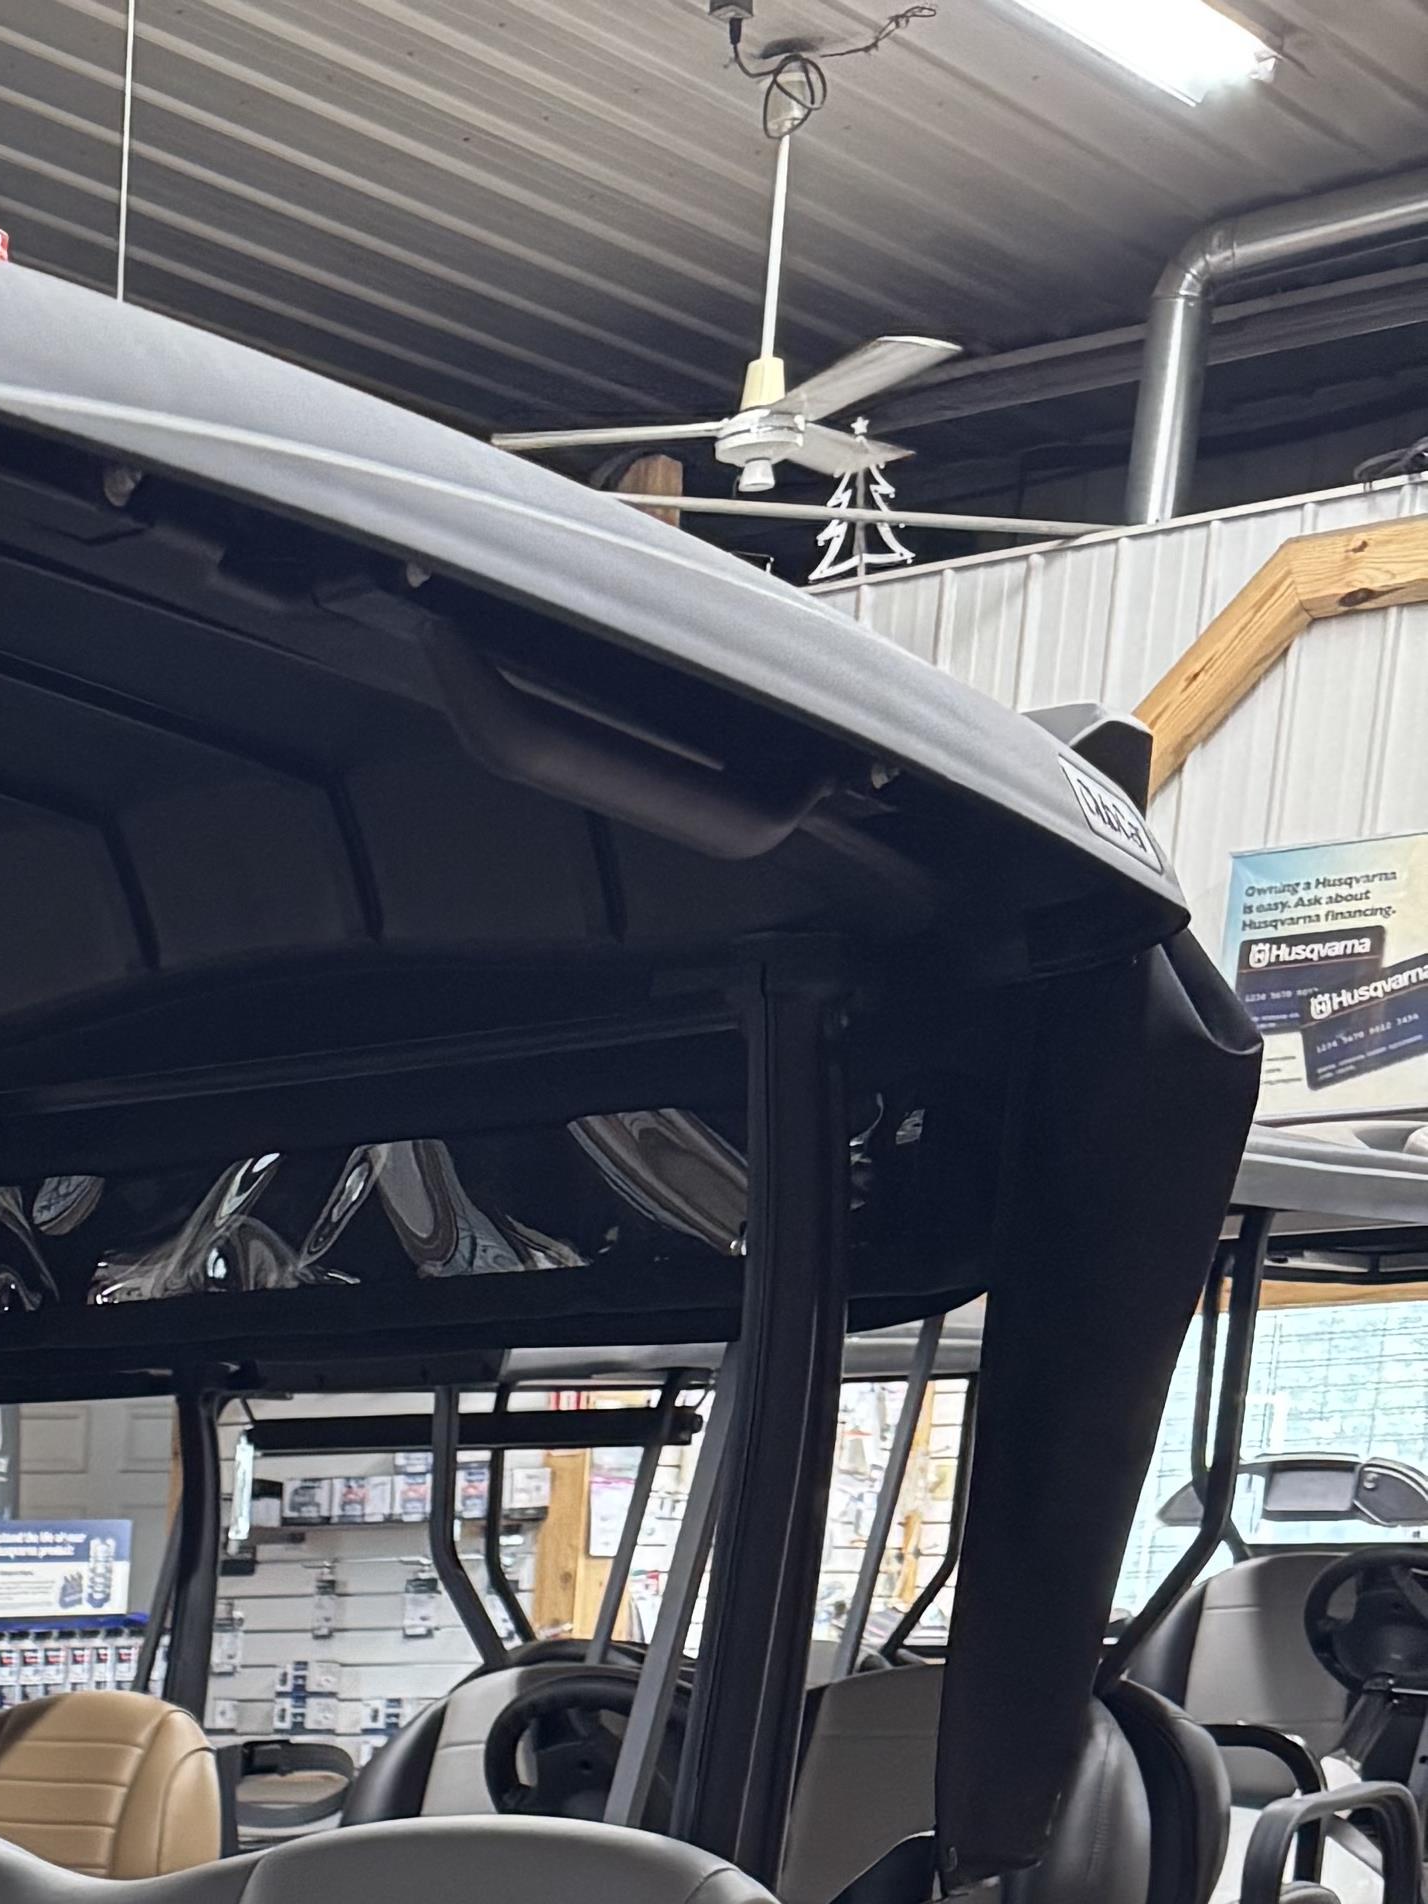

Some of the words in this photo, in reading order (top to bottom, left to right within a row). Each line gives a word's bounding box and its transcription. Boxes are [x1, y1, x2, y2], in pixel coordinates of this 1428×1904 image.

[1244, 882, 1300, 898] Owning
[1302, 879, 1312, 891] a
[1314, 870, 1398, 889] Husqvarna
[1242, 903, 1254, 915] is
[1255, 900, 1291, 915] easy.
[1293, 895, 1323, 909] Ask
[1325, 889, 1372, 905] about
[1241, 914, 1321, 932] Husqvarna
[1324, 904, 1397, 923] financing.
[1270, 937, 1371, 962] Husqvarna
